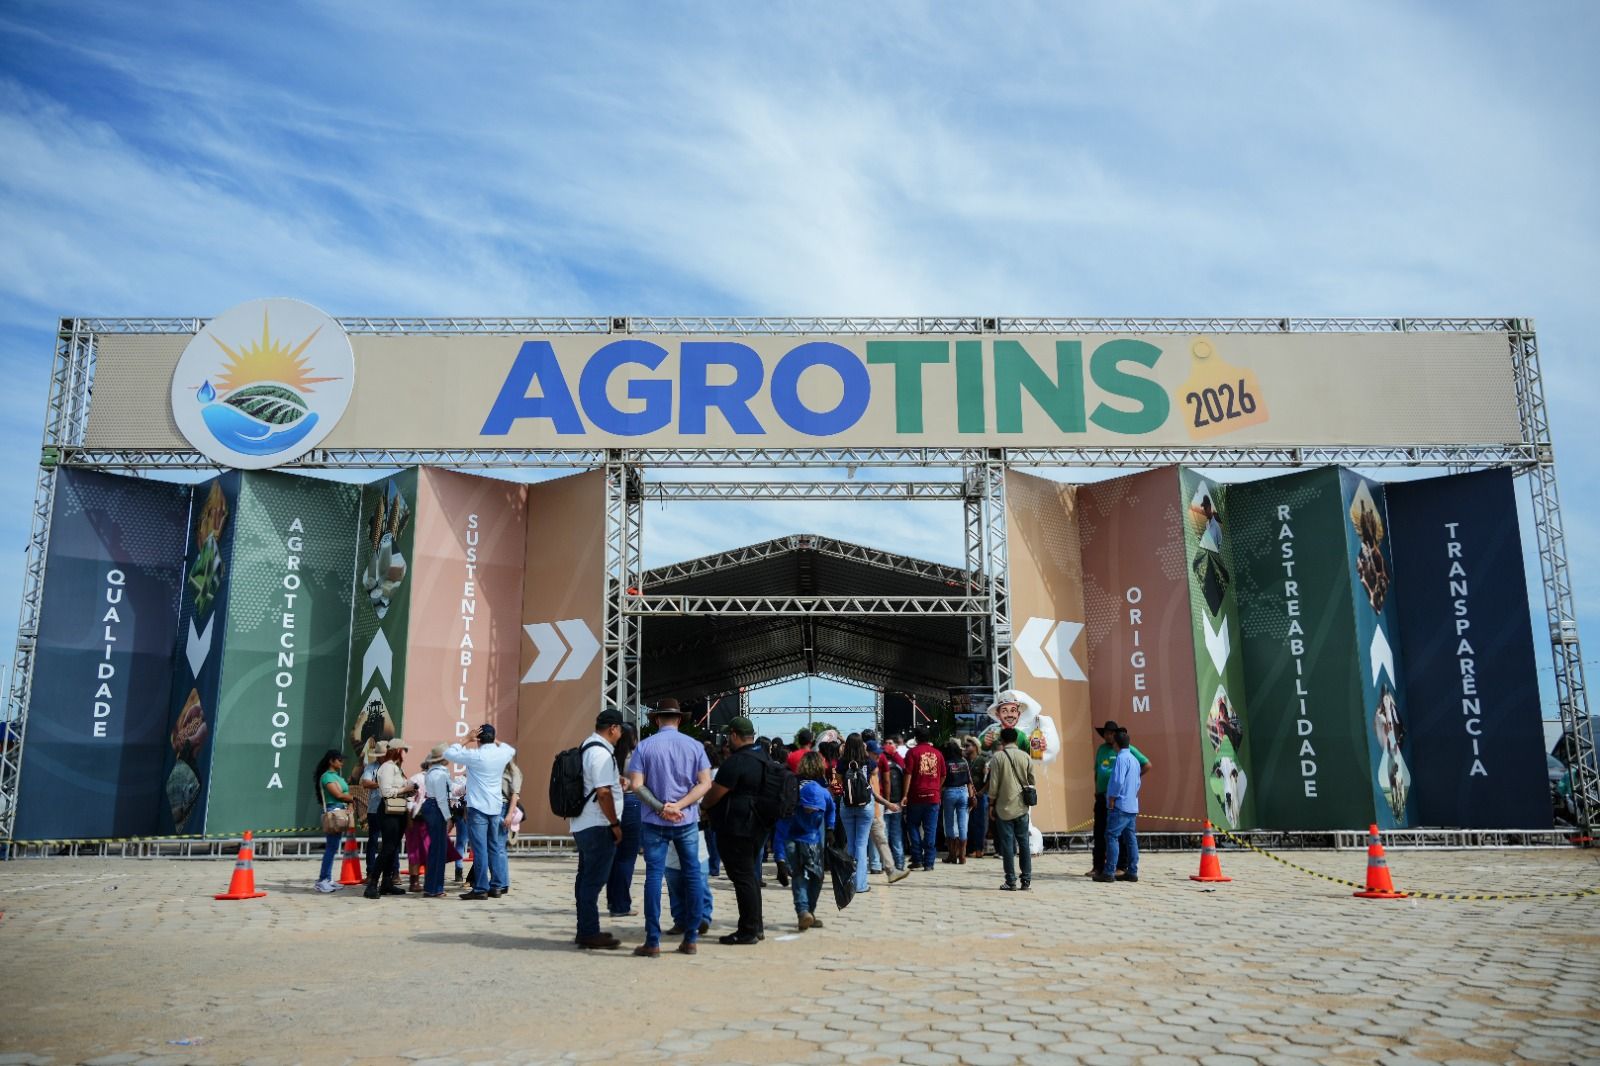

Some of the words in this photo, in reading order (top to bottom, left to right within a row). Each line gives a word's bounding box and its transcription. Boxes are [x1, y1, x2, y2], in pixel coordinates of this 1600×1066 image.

[480, 338, 1170, 436] AGROTINS
[1186, 379, 1256, 428] 2026
[93, 569, 126, 738] QUALIDADE
[266, 517, 304, 789] AGROTECNOLOGIA
[453, 514, 479, 780] SUSTENTABILIDD
[1126, 586, 1151, 713] ORIGEM
[1277, 504, 1318, 797] RASTREABILIDADE
[1445, 522, 1488, 776] TRANSPARÊNCIA
